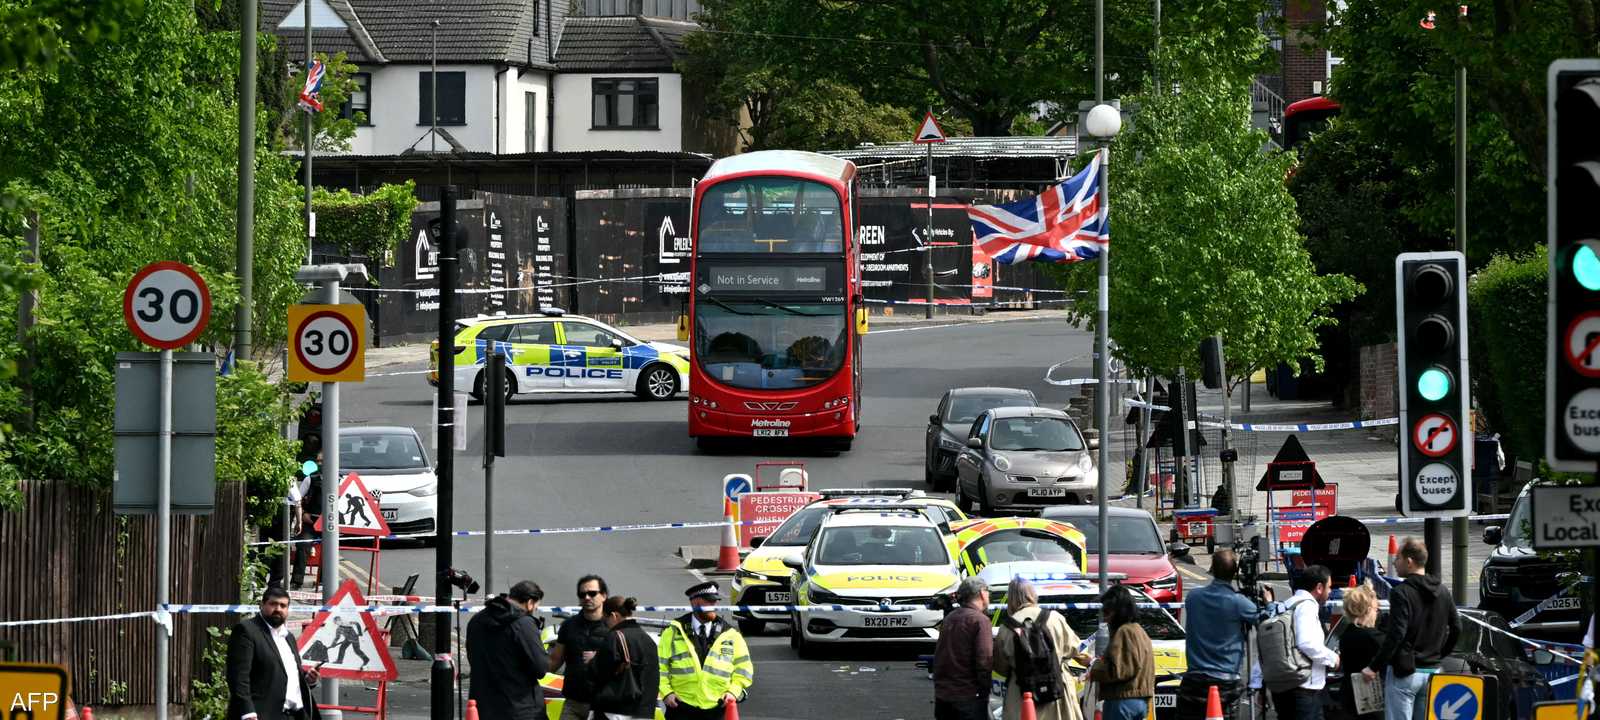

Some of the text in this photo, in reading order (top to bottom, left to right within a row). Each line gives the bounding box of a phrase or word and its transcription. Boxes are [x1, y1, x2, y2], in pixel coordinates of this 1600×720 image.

[860, 225, 885, 244] REEN
[717, 275, 779, 285] Not in Service
[137, 287, 199, 325] 30
[304, 330, 350, 357] 30
[526, 367, 623, 379] POLICE
[752, 419, 791, 427] Metroline
[1419, 475, 1455, 487] Except
[1422, 486, 1453, 495] buses
[750, 526, 776, 534] LIGHT
[1544, 523, 1599, 541] Local
[864, 616, 888, 626] BX20
